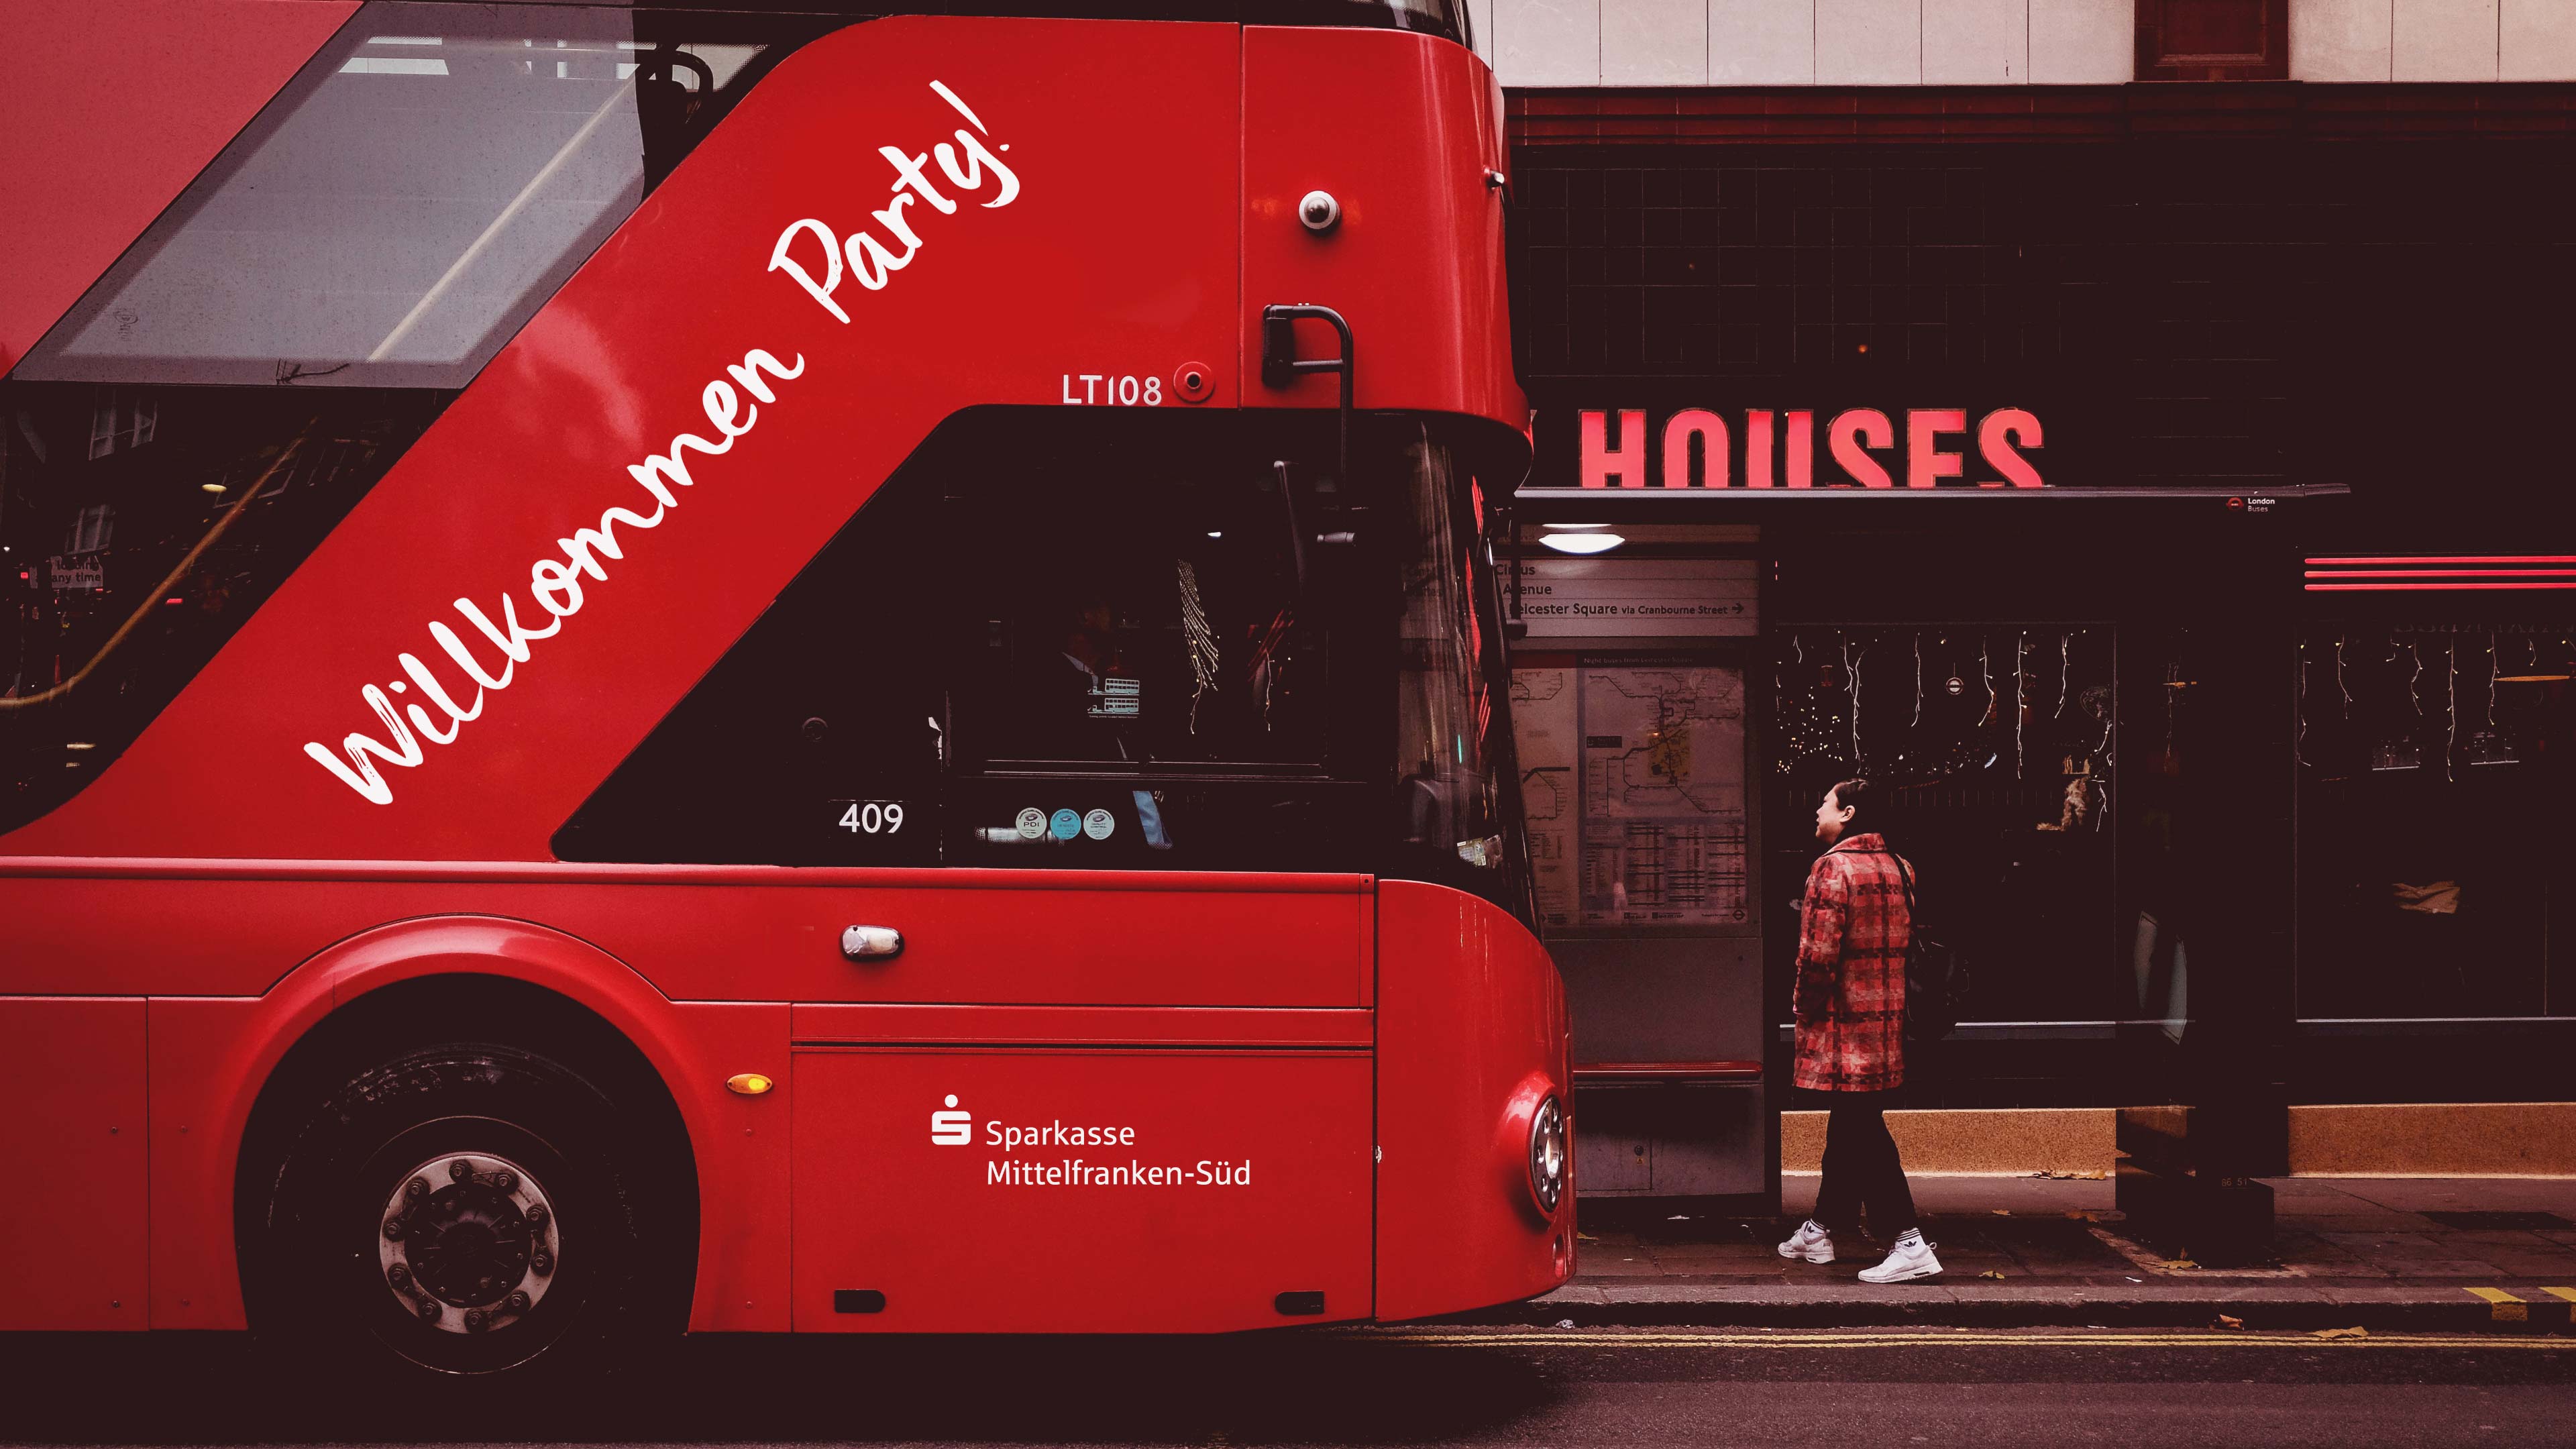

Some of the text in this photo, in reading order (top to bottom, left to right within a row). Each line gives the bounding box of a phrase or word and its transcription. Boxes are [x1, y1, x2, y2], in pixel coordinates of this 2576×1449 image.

[1063, 375, 1162, 406] LT108
[304, 80, 1020, 804] Willkommen Party!
[1578, 407, 2045, 488] HOUSES
[76, 572, 101, 582] time
[1495, 564, 1536, 575] Cius
[1503, 584, 1552, 595] Aenue
[1509, 603, 1728, 616] eicester Square via Cranbourne Street
[839, 804, 903, 833] 409
[986, 1120, 1135, 1152] Sparkasse
[987, 1159, 1250, 1185] Mittelfranken-Süd
